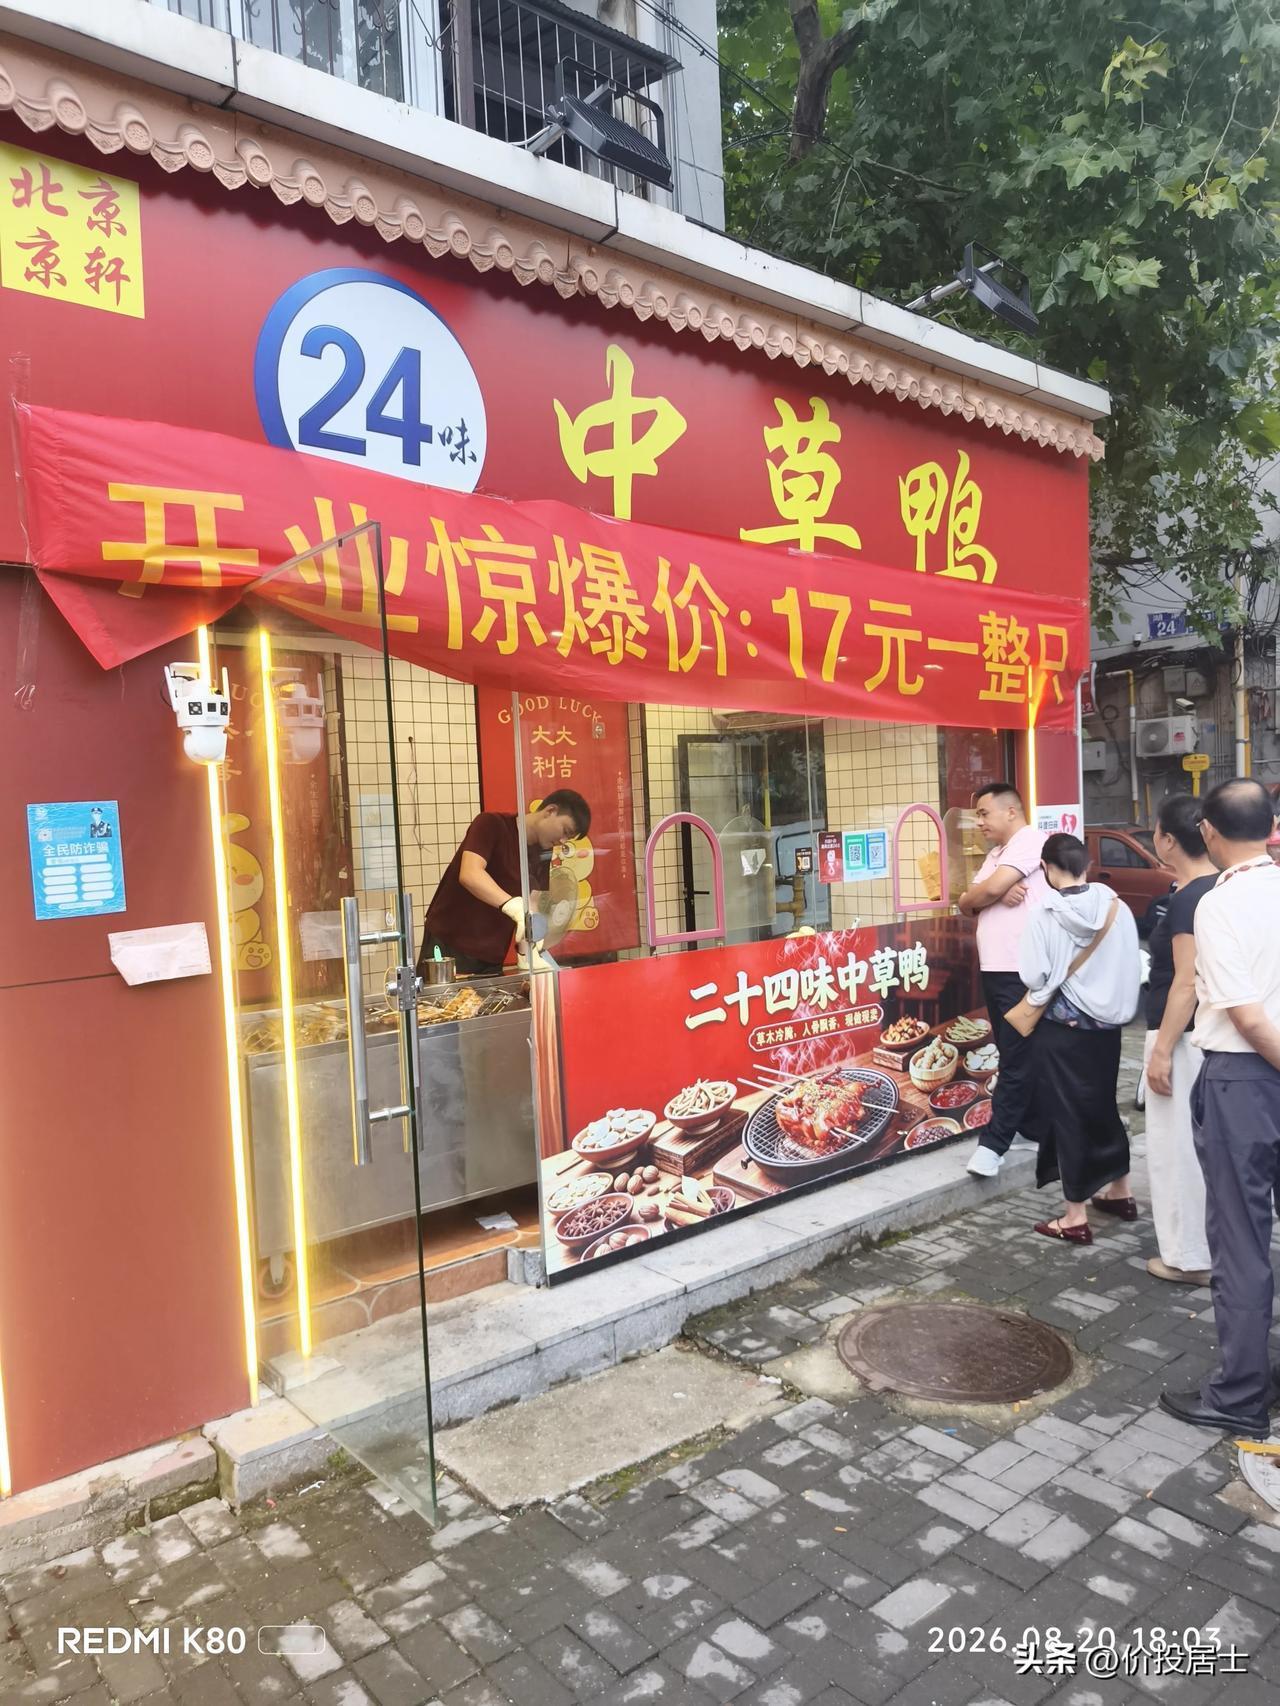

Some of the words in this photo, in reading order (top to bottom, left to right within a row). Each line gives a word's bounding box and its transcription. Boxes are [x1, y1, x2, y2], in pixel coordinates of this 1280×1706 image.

[9, 162, 129, 239] 北京
[15, 228, 131, 305] 京轩
[298, 324, 477, 466] 24味
[552, 344, 997, 584] 中草鸭
[1157, 620, 1176, 636] 24
[560, 697, 602, 723] LUCK
[43, 841, 109, 857] 全民防诈骗
[685, 941, 930, 1030] 二十四味中草鸭
